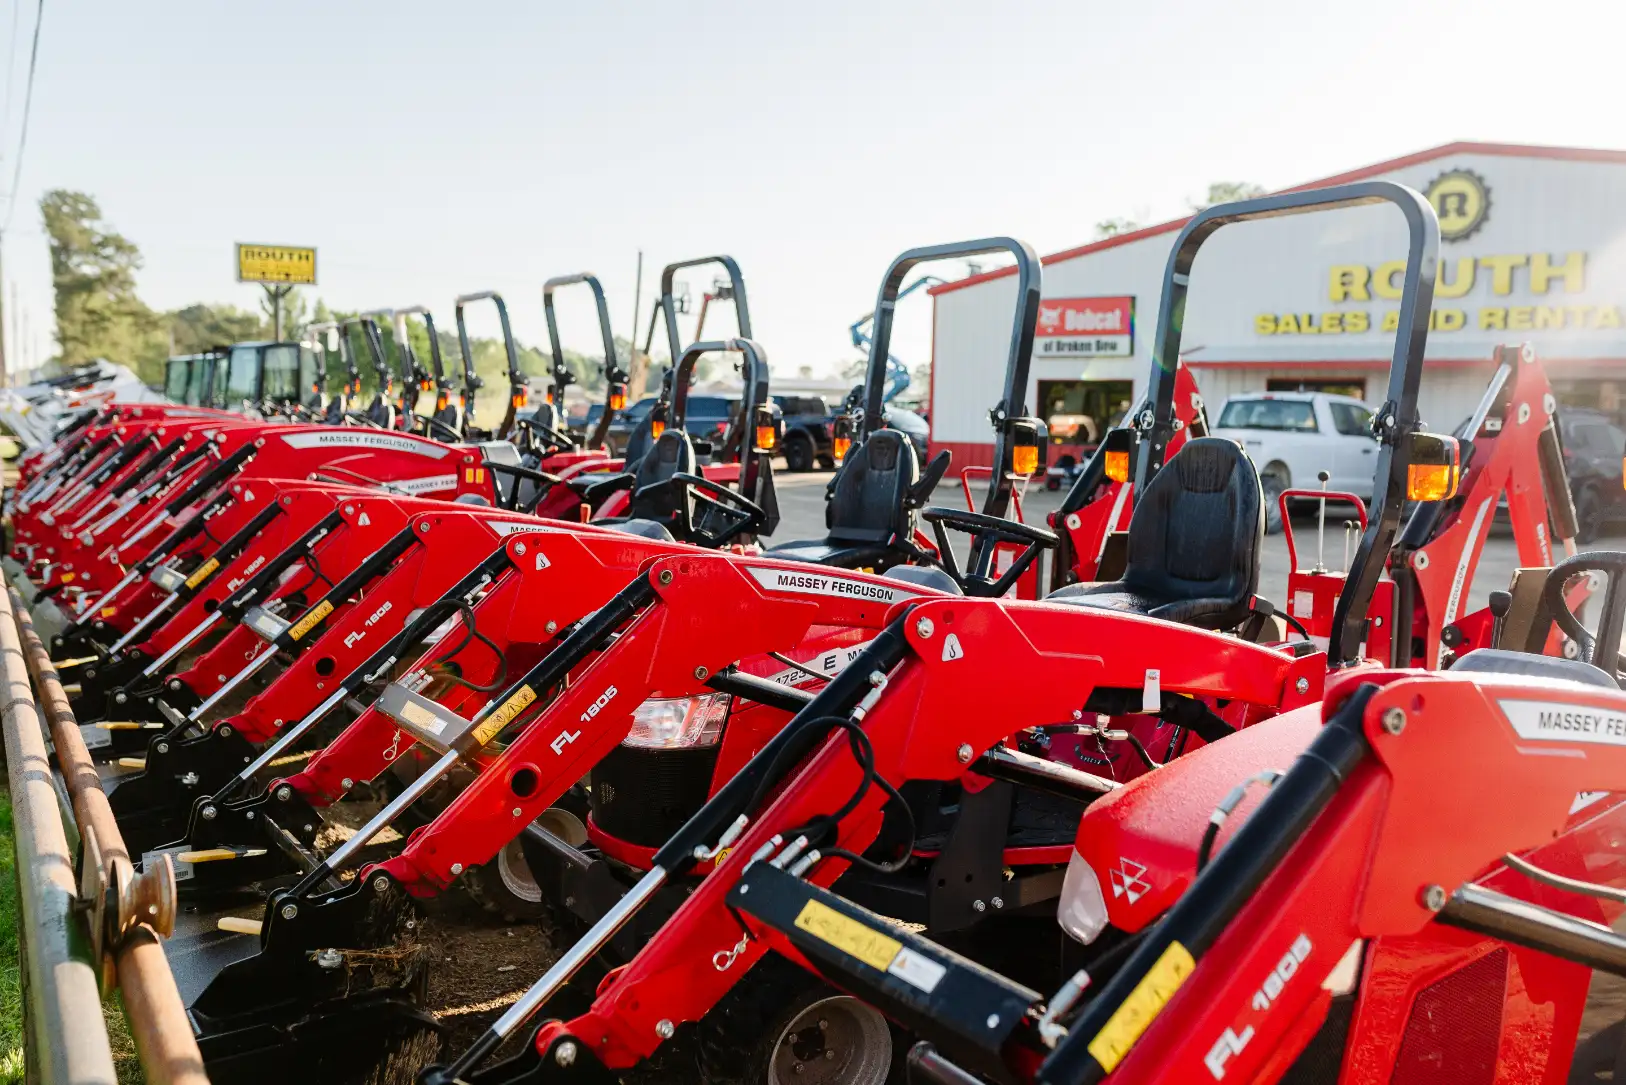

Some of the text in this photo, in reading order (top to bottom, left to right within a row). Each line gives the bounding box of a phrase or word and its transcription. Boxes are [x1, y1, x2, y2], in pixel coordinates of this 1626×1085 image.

[1438, 192, 1468, 218] R
[243, 250, 311, 261] ROUTH
[1065, 308, 1122, 331] Bobcat
[1255, 305, 1622, 335] SALES AD RENTA
[1043, 342, 1053, 352] of
[1056, 341, 1092, 352] Broken
[319, 435, 417, 450] MASSEY FERGUSON
[777, 575, 894, 601] MASSEY FERGUSON
[343, 600, 393, 649] FL 1805
[824, 655, 837, 670] E
[549, 684, 618, 756] FL 1805
[1538, 711, 1602, 733] MASSEY
[1203, 1024, 1255, 1081] FL
